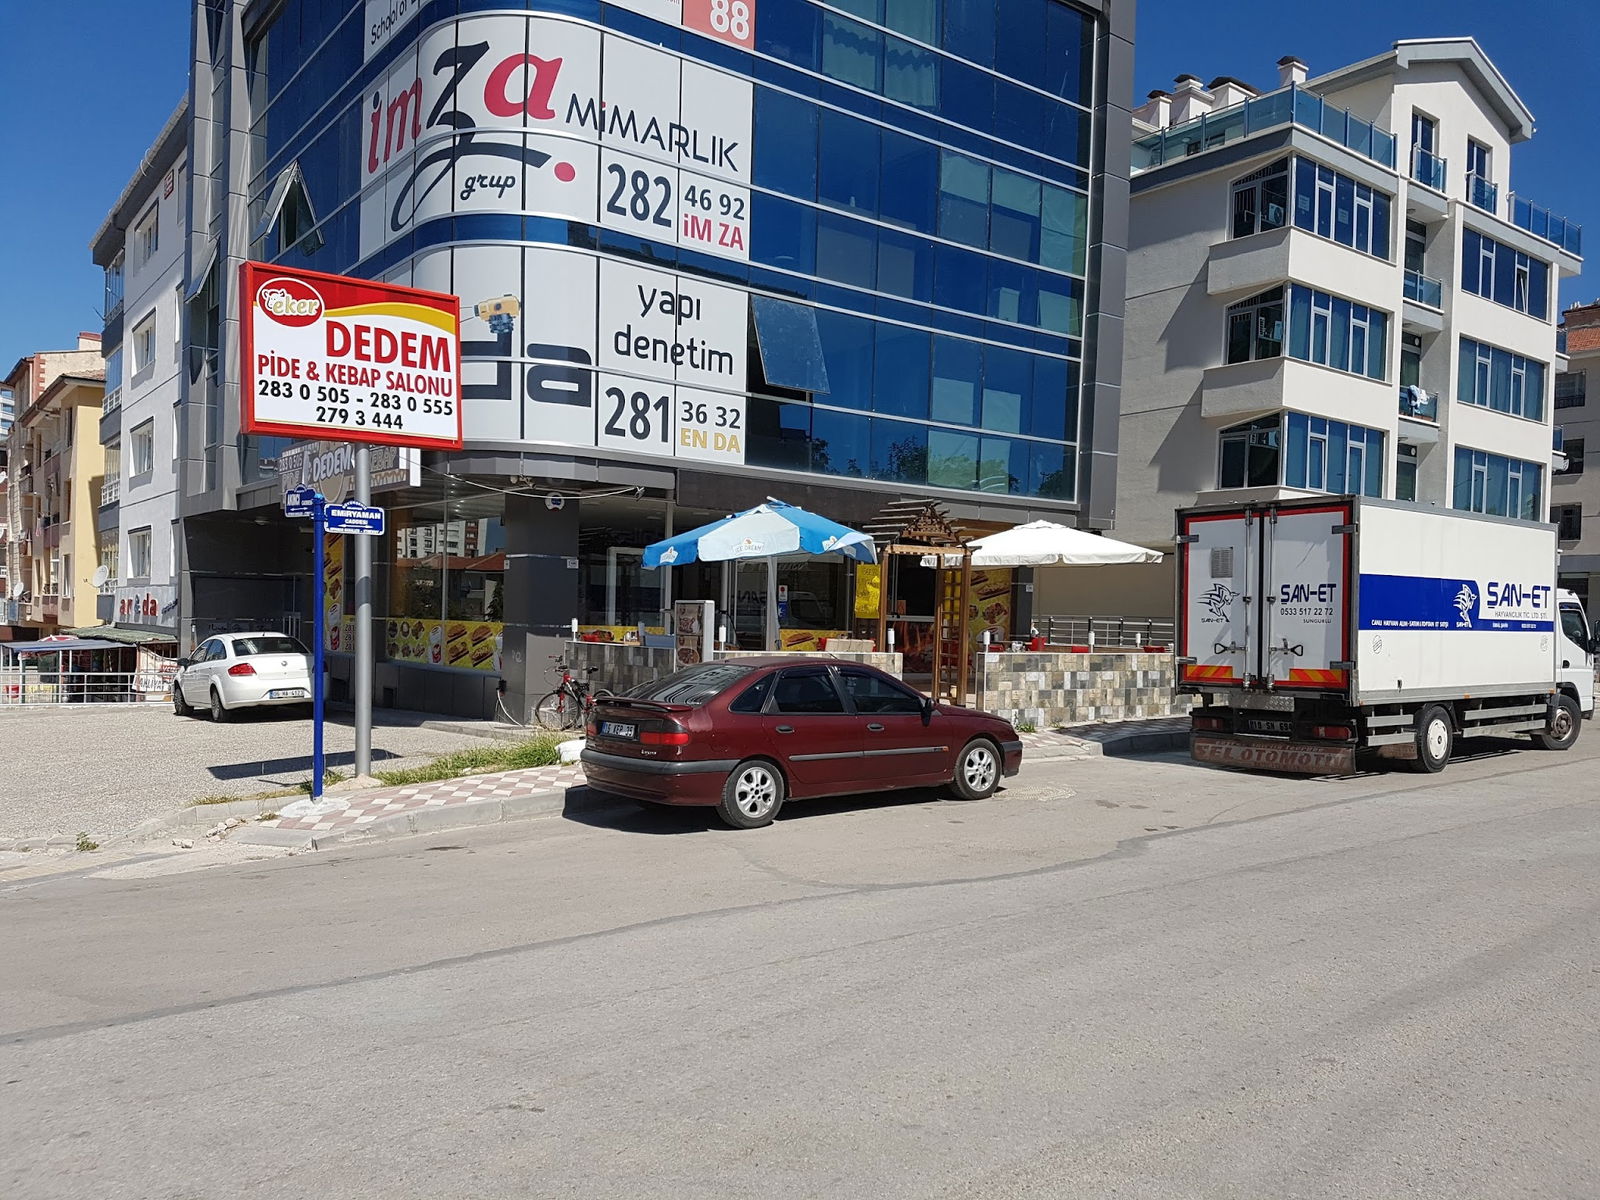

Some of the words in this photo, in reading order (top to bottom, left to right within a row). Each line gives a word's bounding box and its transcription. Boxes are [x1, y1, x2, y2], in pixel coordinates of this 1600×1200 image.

[710, 0, 750, 40] 88
[460, 173, 516, 201] grup
[606, 163, 672, 228] 282
[684, 185, 712, 211] 46
[719, 194, 745, 220] 92
[718, 223, 744, 251] ZA
[273, 296, 318, 315] eker
[637, 284, 701, 326] yapı
[326, 320, 451, 373] DEDEM
[614, 323, 733, 375] denetim
[258, 350, 300, 379] PİDE
[306, 361, 320, 381] &
[326, 363, 381, 388] KEBAP
[386, 370, 453, 397] SALONU
[258, 380, 293, 398] 283
[299, 384, 310, 400] 0
[317, 386, 349, 404] 505
[370, 392, 401, 410] 283
[407, 396, 417, 412] 0
[423, 399, 453, 416] 555
[604, 386, 669, 443] 281
[681, 401, 708, 424] 36
[715, 406, 741, 429] 32
[316, 406, 349, 424] 279
[355, 411, 365, 426] 3
[371, 413, 403, 430] 444
[680, 427, 707, 449] EN
[713, 432, 741, 453] DA
[313, 445, 352, 482] DEDEM
[1280, 607, 1297, 616] 0533
[1299, 607, 1311, 616] 517
[1313, 607, 1323, 616] 22
[1324, 607, 1333, 616] 72
